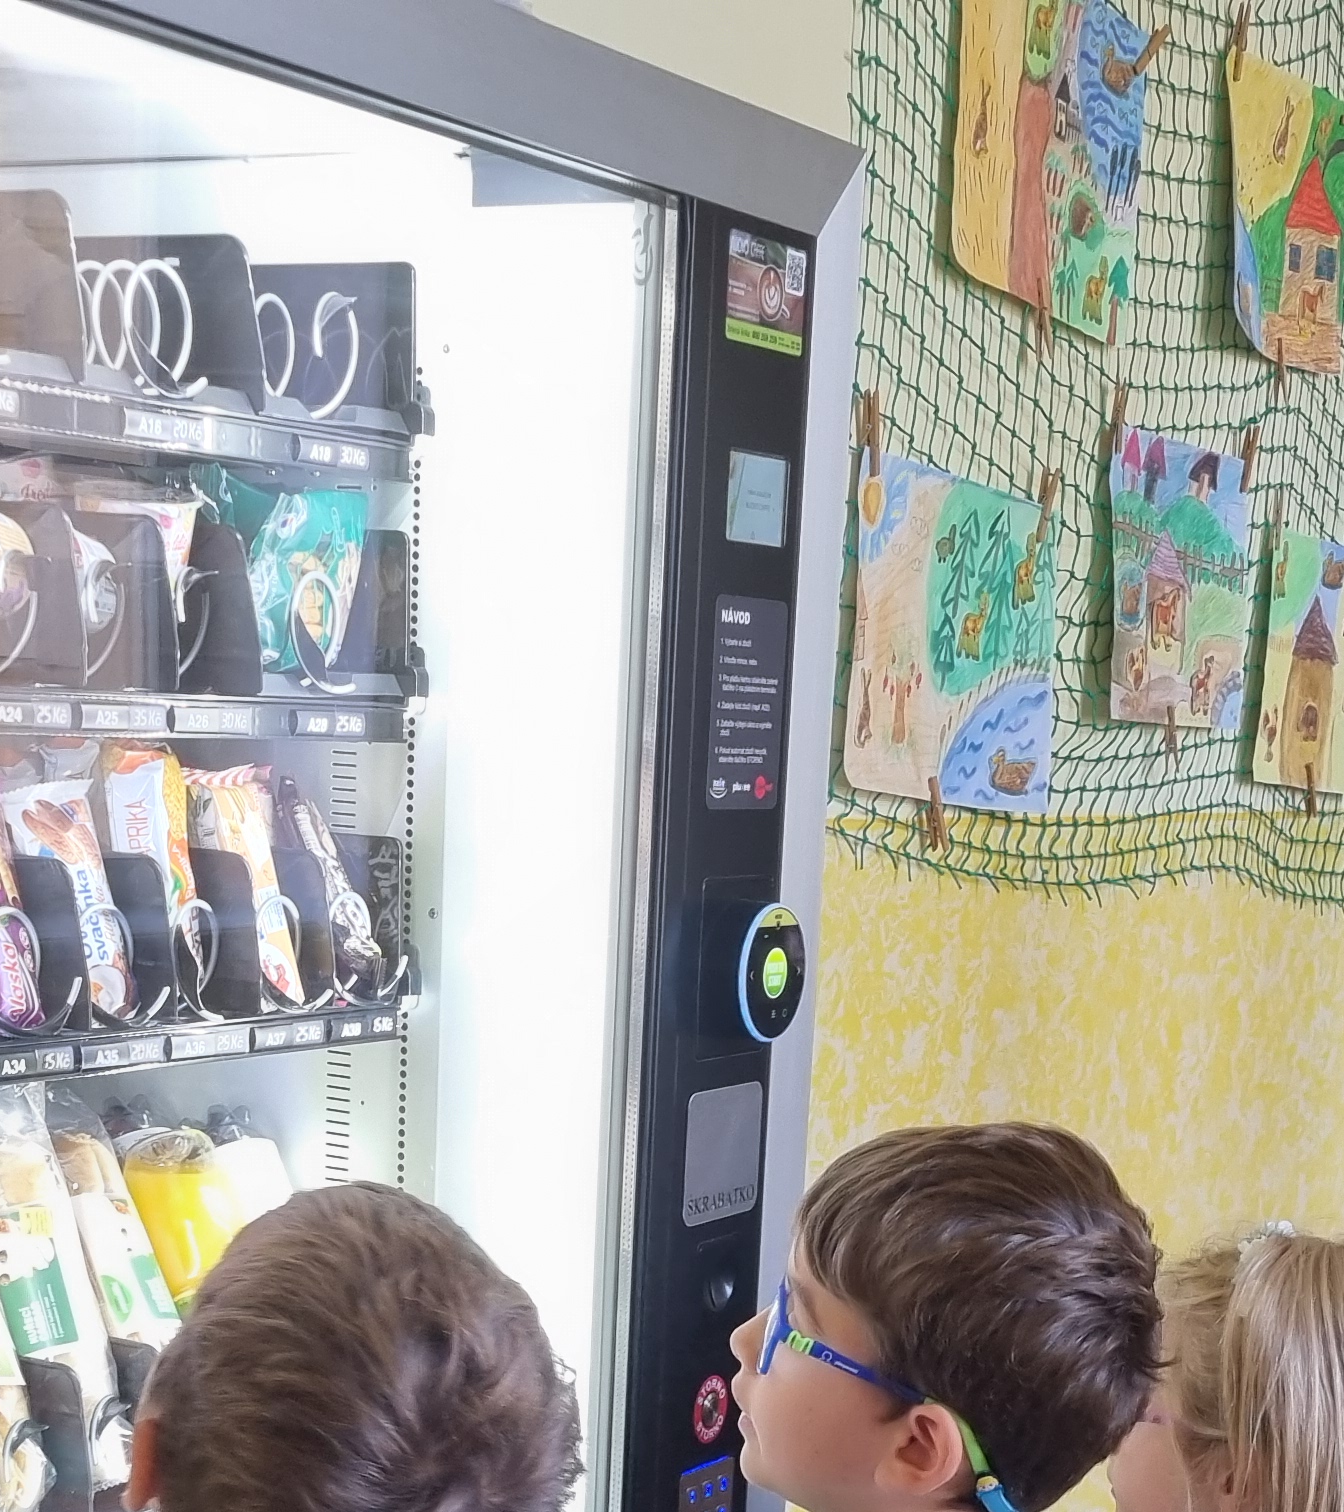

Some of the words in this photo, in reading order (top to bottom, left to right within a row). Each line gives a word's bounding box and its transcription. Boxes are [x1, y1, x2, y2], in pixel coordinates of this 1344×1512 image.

[139, 416, 163, 435] A16
[173, 420, 203, 441] 20Kč
[309, 445, 331, 461] A18
[339, 446, 366, 466] 30Kč
[721, 606, 751, 625] NÁVOD
[36, 706, 68, 725] 25Kč
[95, 711, 119, 725] A25
[134, 708, 162, 727] 35Kč
[187, 713, 209, 729] A26
[221, 712, 248, 730] 30Kč
[307, 718, 328, 733] A28
[336, 713, 363, 733] 25Kč
[76, 869, 110, 961] svačnka
[265, 1031, 286, 1047] A37
[295, 1025, 322, 1042] 25Kč
[341, 1023, 362, 1038] A38
[95, 1049, 119, 1065] A35
[184, 1040, 206, 1055] A36
[1, 1058, 26, 1076] A34
[697, 1378, 726, 1405] STORNO
[697, 1415, 724, 1440] STORNO
